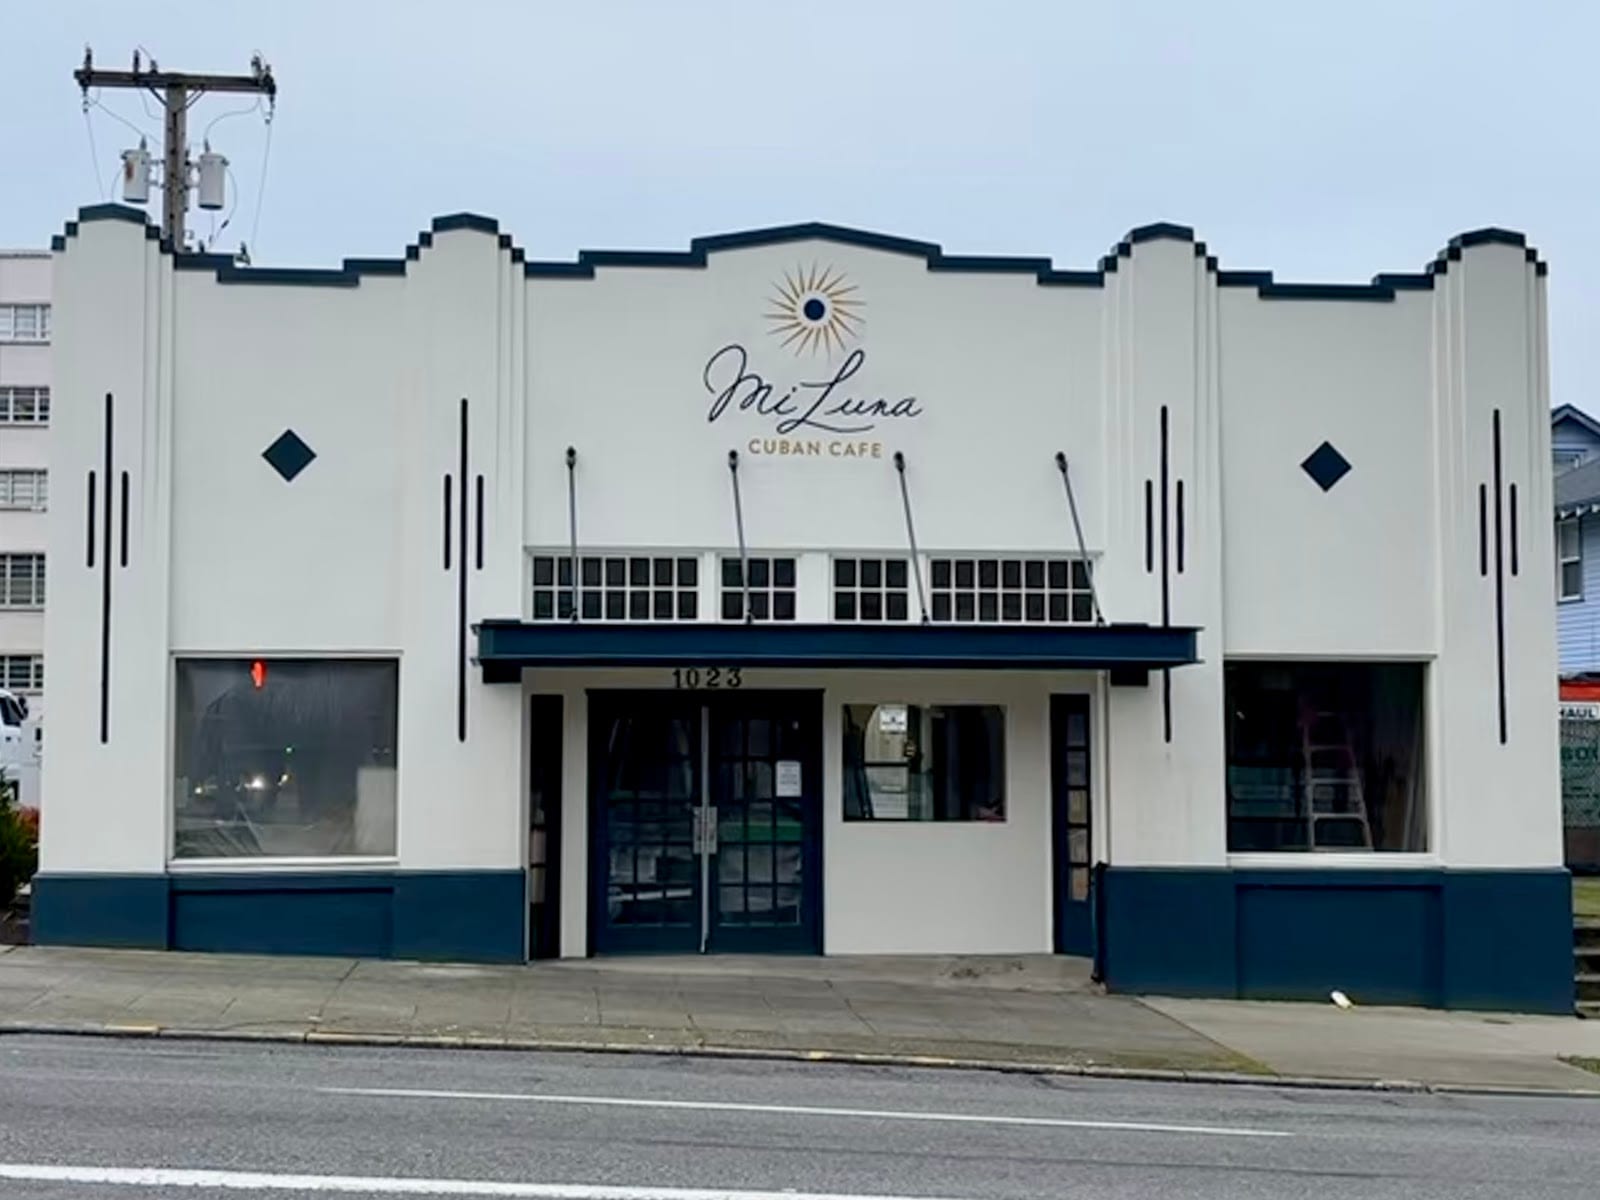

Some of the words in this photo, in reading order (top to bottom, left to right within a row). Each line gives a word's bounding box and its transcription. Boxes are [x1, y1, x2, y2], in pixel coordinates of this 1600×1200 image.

[703, 344, 798, 423] Mi
[776, 349, 923, 434] Luna
[749, 438, 821, 456] CUBAN
[829, 441, 882, 459] CAFE
[672, 666, 742, 689] 1023
